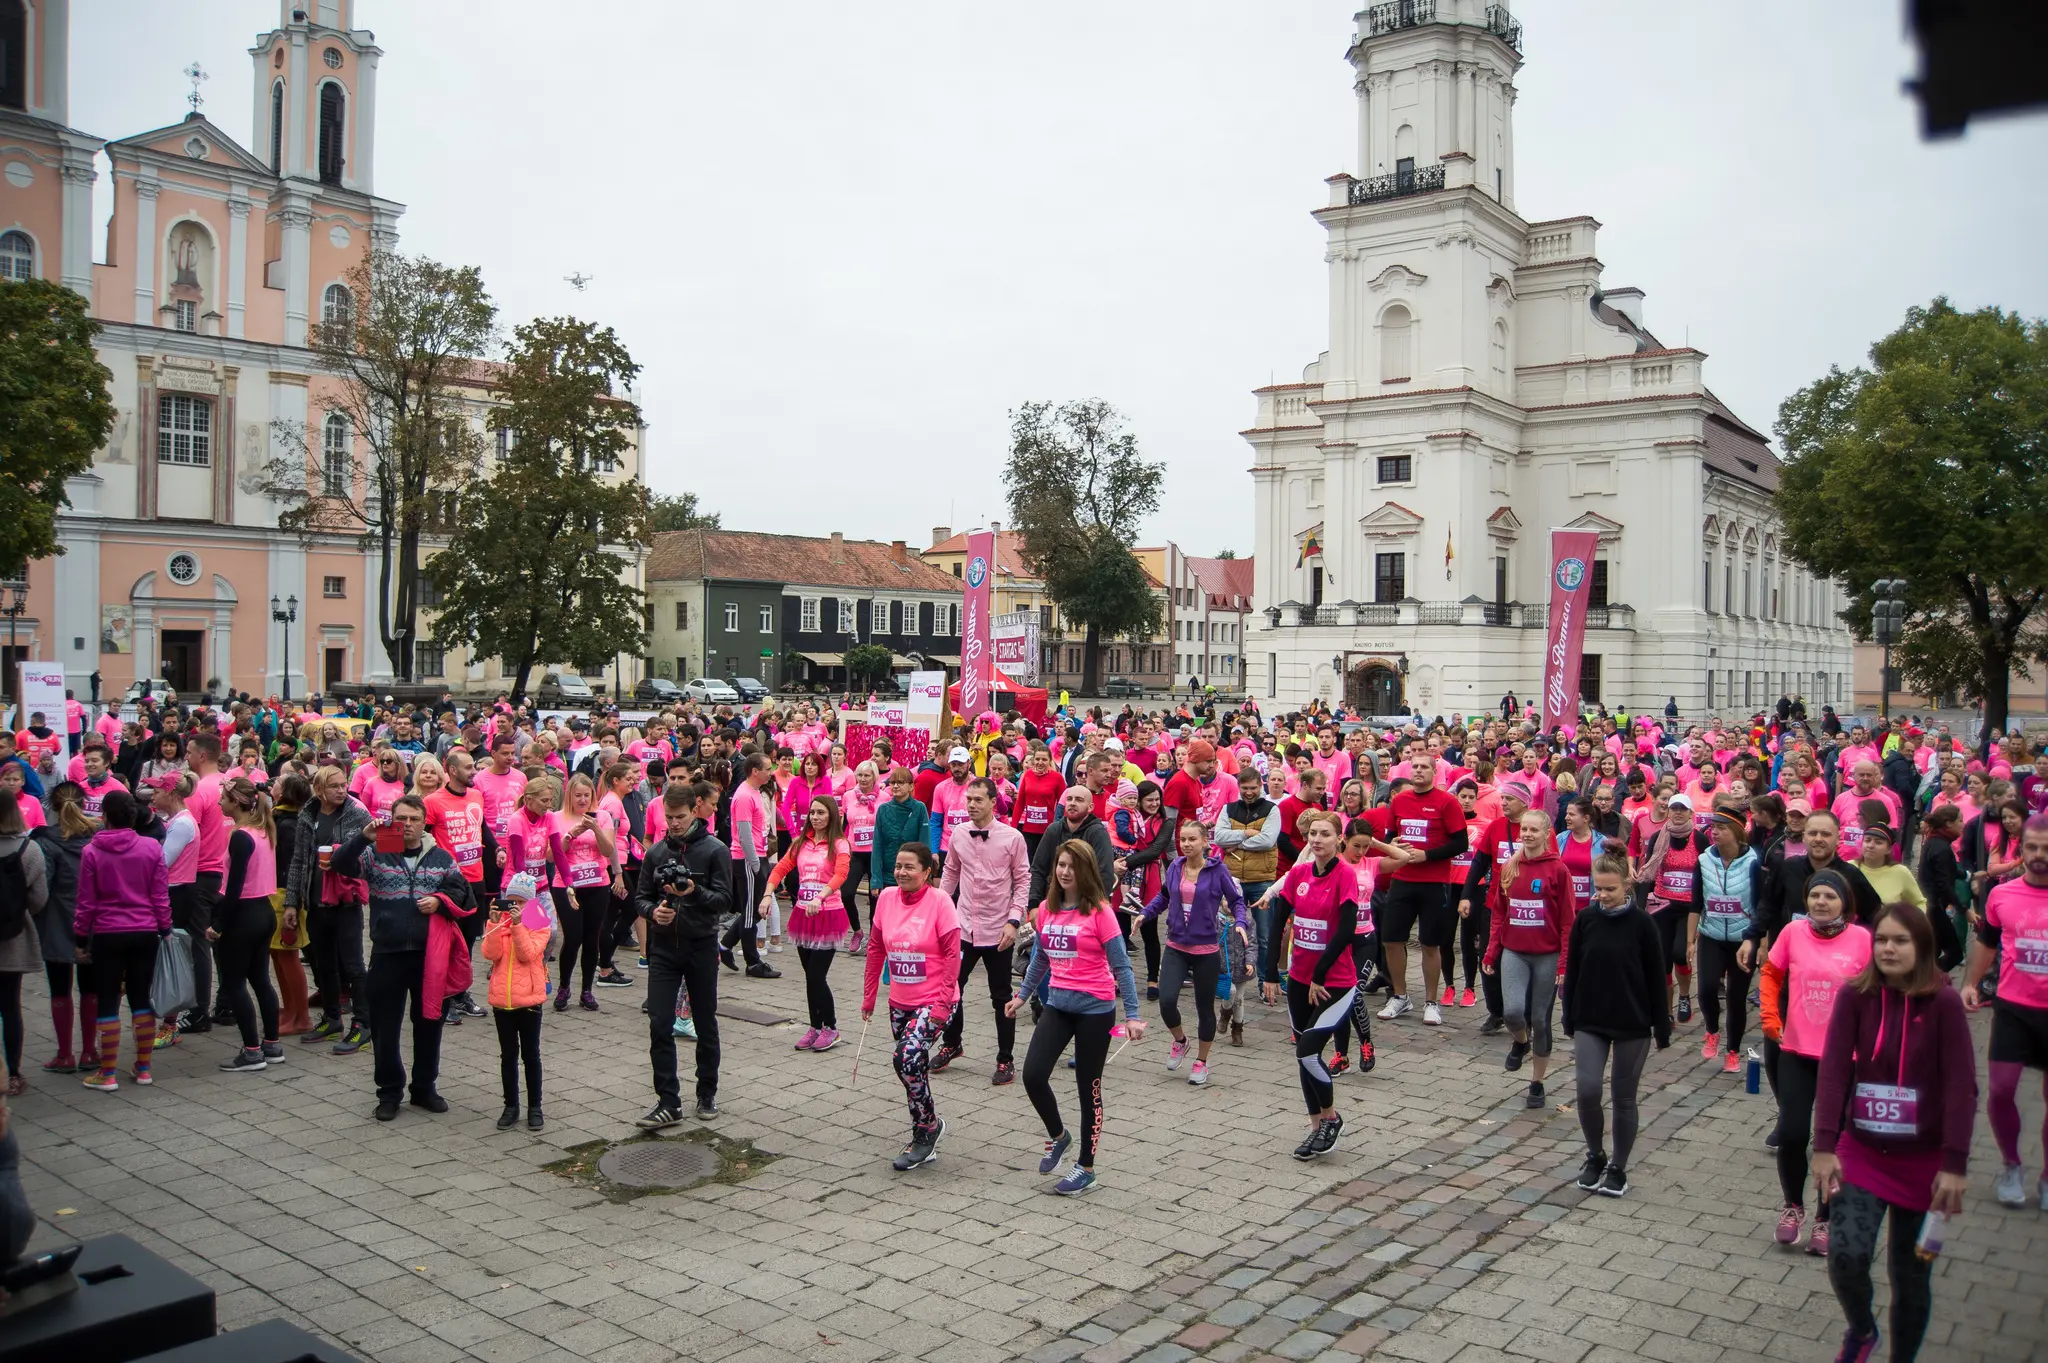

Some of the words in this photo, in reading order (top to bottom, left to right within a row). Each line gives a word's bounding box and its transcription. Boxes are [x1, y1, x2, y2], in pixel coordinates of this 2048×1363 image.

[1552, 600, 1571, 666] Romeo
[928, 686, 941, 694] RUN
[1548, 670, 1568, 717] Alfa
[888, 711, 902, 719] RUN
[85, 803, 100, 811] 112
[446, 819, 466, 828] NES
[1405, 826, 1421, 835] 670
[463, 850, 478, 861] 339
[527, 868, 539, 877] 93
[578, 868, 596, 879] 356
[1669, 878, 1687, 887] 735
[1714, 903, 1733, 912] 615
[1516, 908, 1536, 919] 716
[1298, 928, 1318, 942] 156
[1048, 936, 1068, 949] 705
[895, 963, 918, 975] 704
[1806, 990, 1830, 1001] JAS!
[1092, 1078, 1102, 1105] neo
[1895, 1089, 1909, 1098] km
[1865, 1100, 1901, 1121] 195
[1090, 1107, 1103, 1155] adidas
